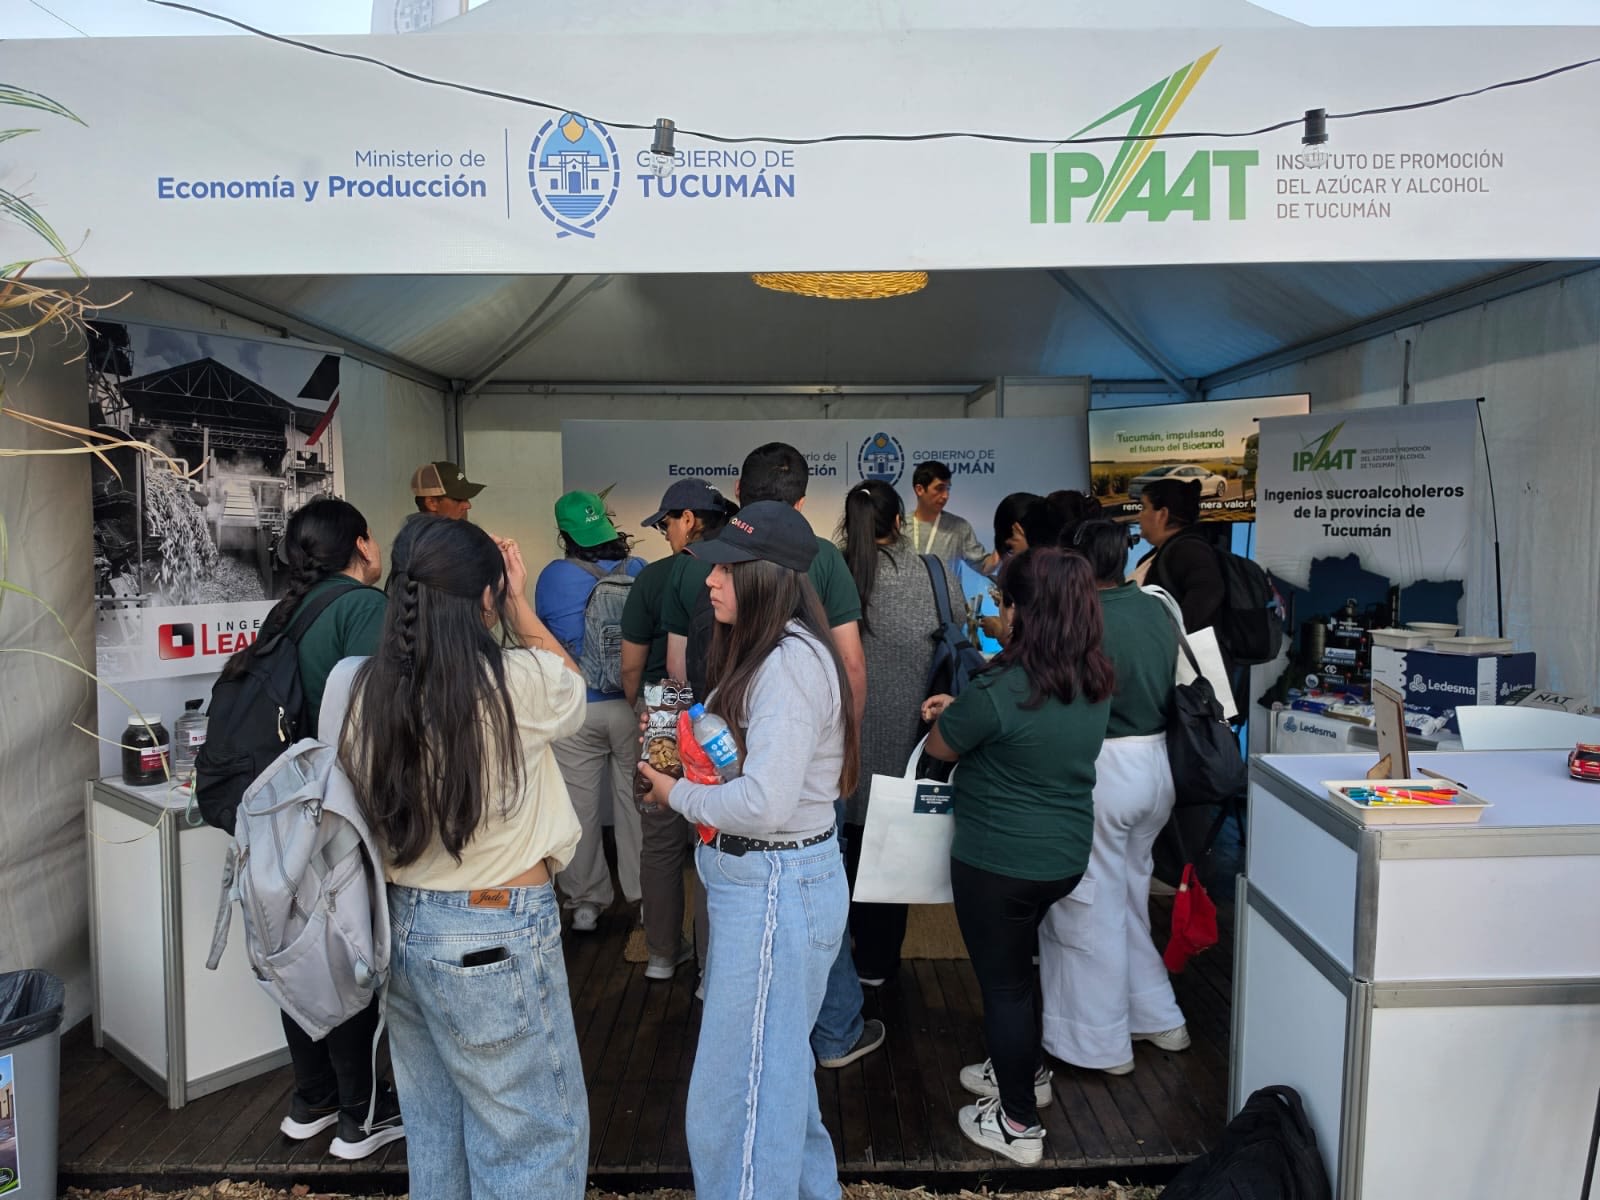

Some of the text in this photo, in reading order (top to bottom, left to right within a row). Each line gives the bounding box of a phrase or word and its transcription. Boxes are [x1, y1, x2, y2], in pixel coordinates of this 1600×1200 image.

[355, 149, 486, 168] Ministerio de
[636, 150, 795, 168] GBIERNO DE
[1276, 149, 1504, 170] INSTUTO DE PROMOCIÓN
[157, 174, 487, 202] Economía y Producción
[636, 168, 795, 198] TUCUMÁN
[1276, 175, 1490, 194] DEL AZÚCAR Y ALCOHOL
[1277, 199, 1391, 218] DE TUCUMÁN
[1116, 428, 1225, 444] Tucumán, impulsando
[912, 449, 995, 460] GOBIERNO DE
[1129, 440, 1225, 453] el futuro del Bioetanol
[823, 451, 837, 461] de
[668, 463, 739, 476] Economía
[1264, 487, 1323, 504] Ingenios
[1326, 484, 1464, 500] sucroalcoholeros
[1224, 500, 1248, 508] valor
[1294, 504, 1425, 521] de la provincia de
[1322, 523, 1391, 537] Tucumán
[1428, 679, 1476, 696] Ledesma
[1299, 721, 1337, 739] Ledesma
